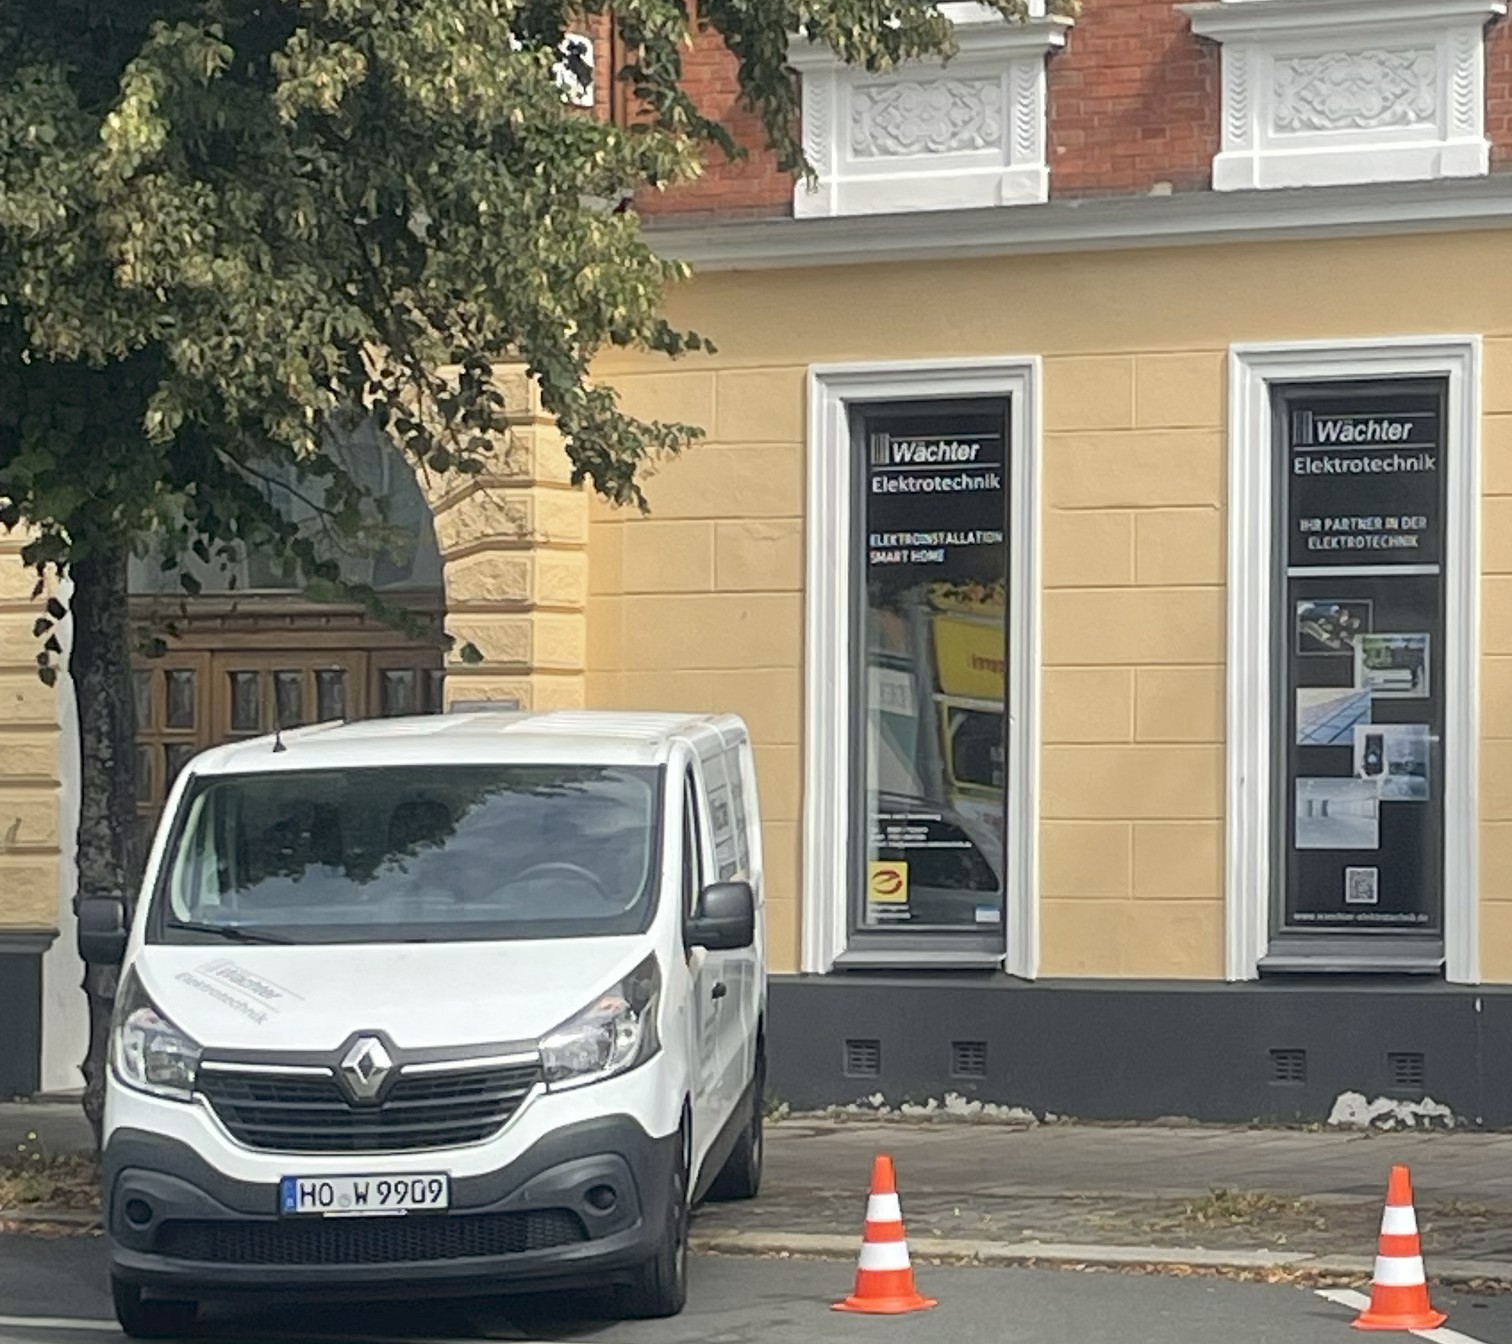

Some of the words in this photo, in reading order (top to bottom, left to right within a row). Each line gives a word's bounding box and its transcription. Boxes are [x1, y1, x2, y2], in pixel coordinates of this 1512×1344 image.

[1316, 419, 1413, 443] Wächter
[892, 440, 980, 463] Wächter
[1294, 453, 1436, 475] Elektrotechnik
[872, 473, 1000, 493] Elektrotechnik
[1324, 517, 1383, 531] PARTNER
[1401, 516, 1428, 530] DER
[1308, 535, 1419, 550] ELEKTROTECHNIK
[869, 549, 909, 564] SMART
[300, 1182, 334, 1207] HO
[353, 1182, 370, 1205] W
[376, 1178, 443, 1205] 9909
